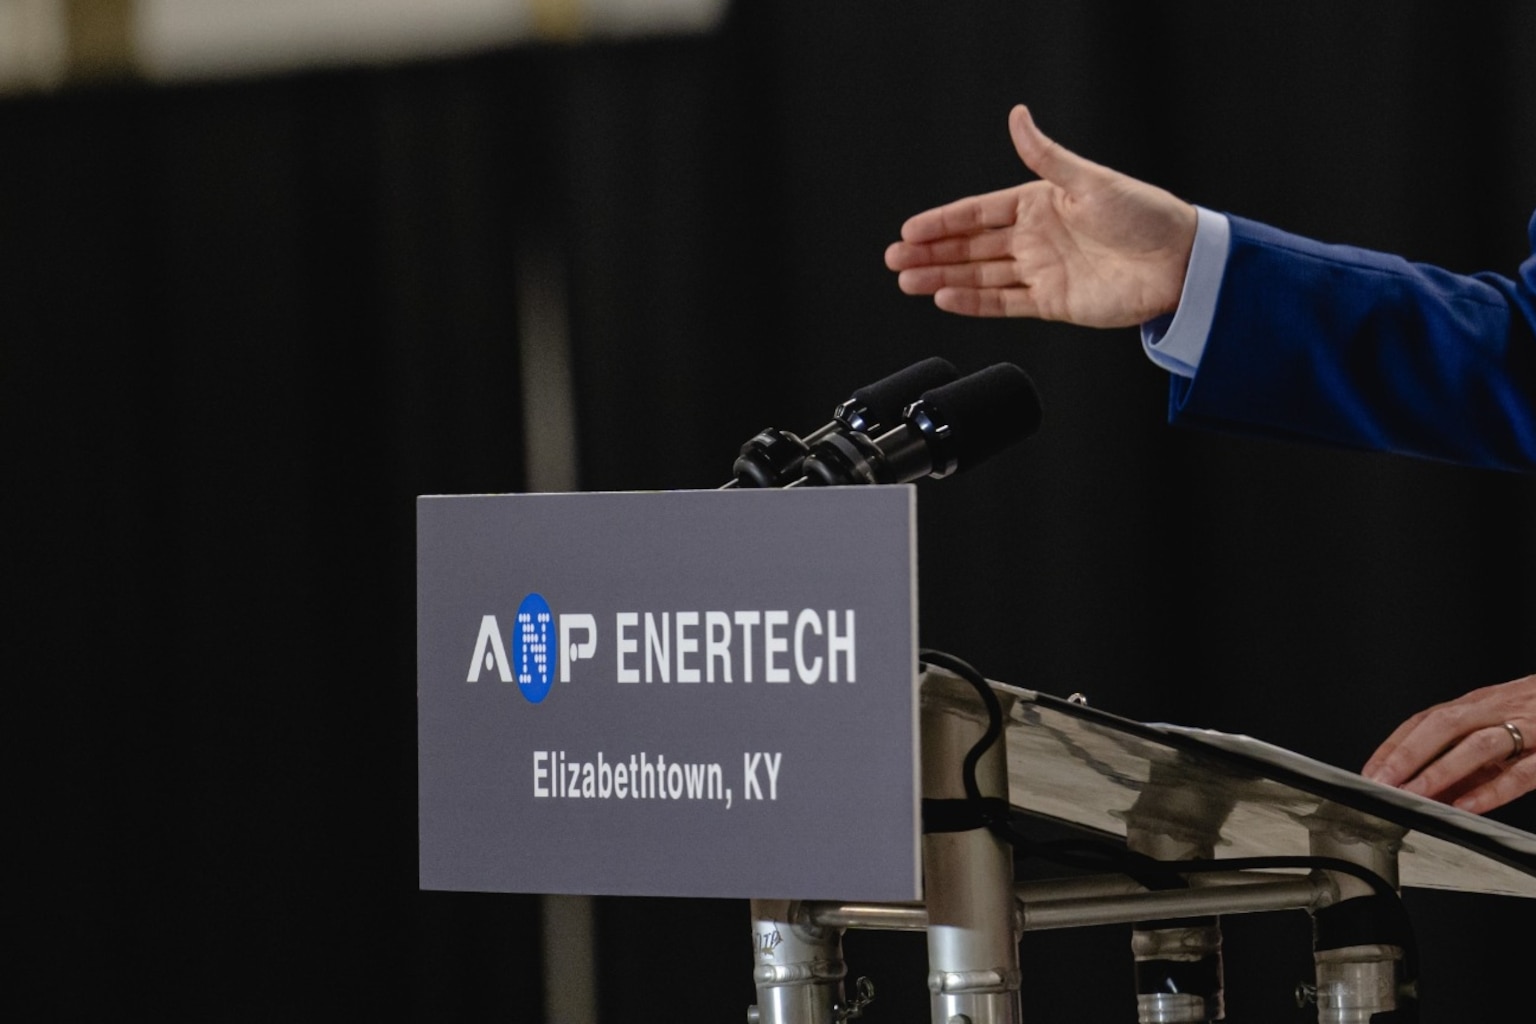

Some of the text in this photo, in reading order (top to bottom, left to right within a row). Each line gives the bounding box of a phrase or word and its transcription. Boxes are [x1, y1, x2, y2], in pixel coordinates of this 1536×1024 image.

[466, 608, 856, 685] ANP ENERTECH
[533, 750, 782, 809] Elizabethtown, KY
